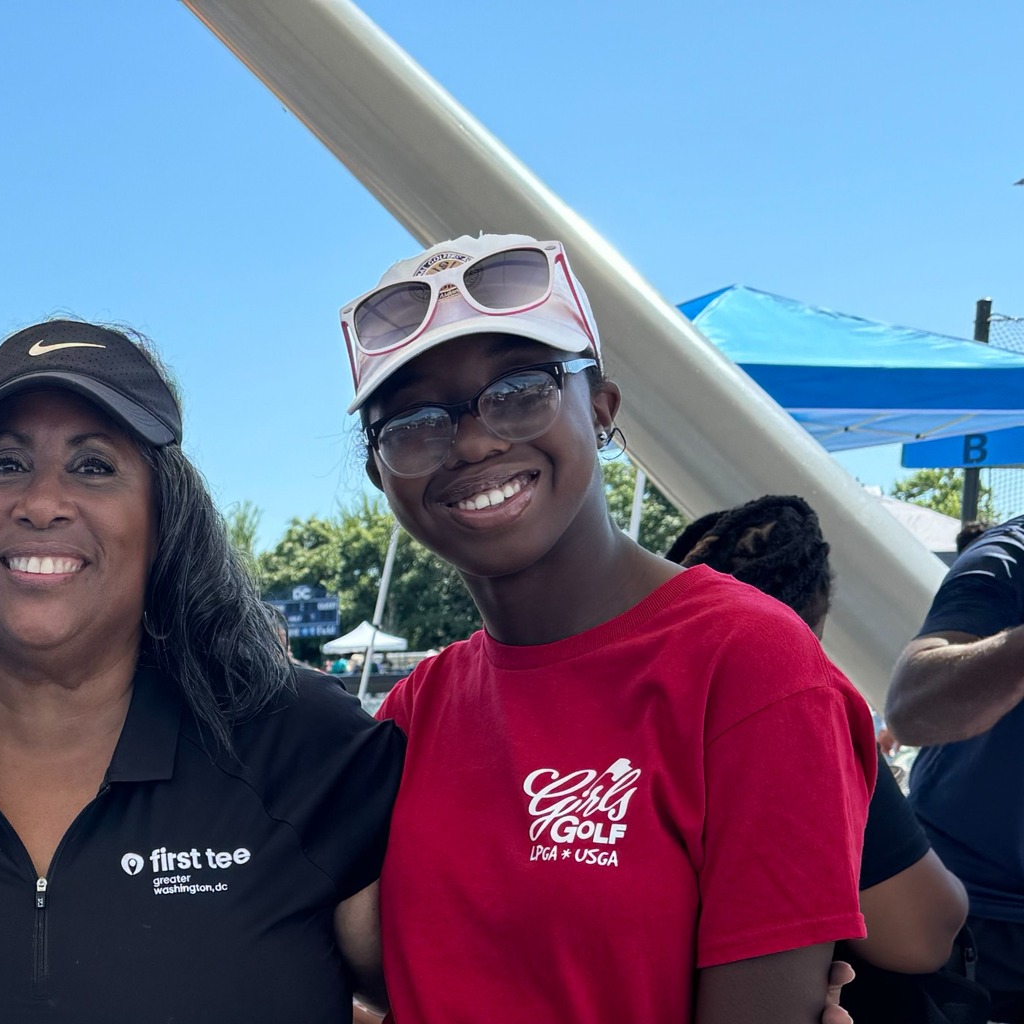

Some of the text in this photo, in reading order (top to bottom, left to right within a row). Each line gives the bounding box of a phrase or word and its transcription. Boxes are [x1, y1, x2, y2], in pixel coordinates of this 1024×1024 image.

[963, 434, 988, 464] B
[523, 759, 642, 842] Girls
[550, 815, 627, 844] GOLF
[149, 846, 251, 873] first tee
[529, 845, 619, 867] LPGA USGA
[153, 875, 192, 888] greater
